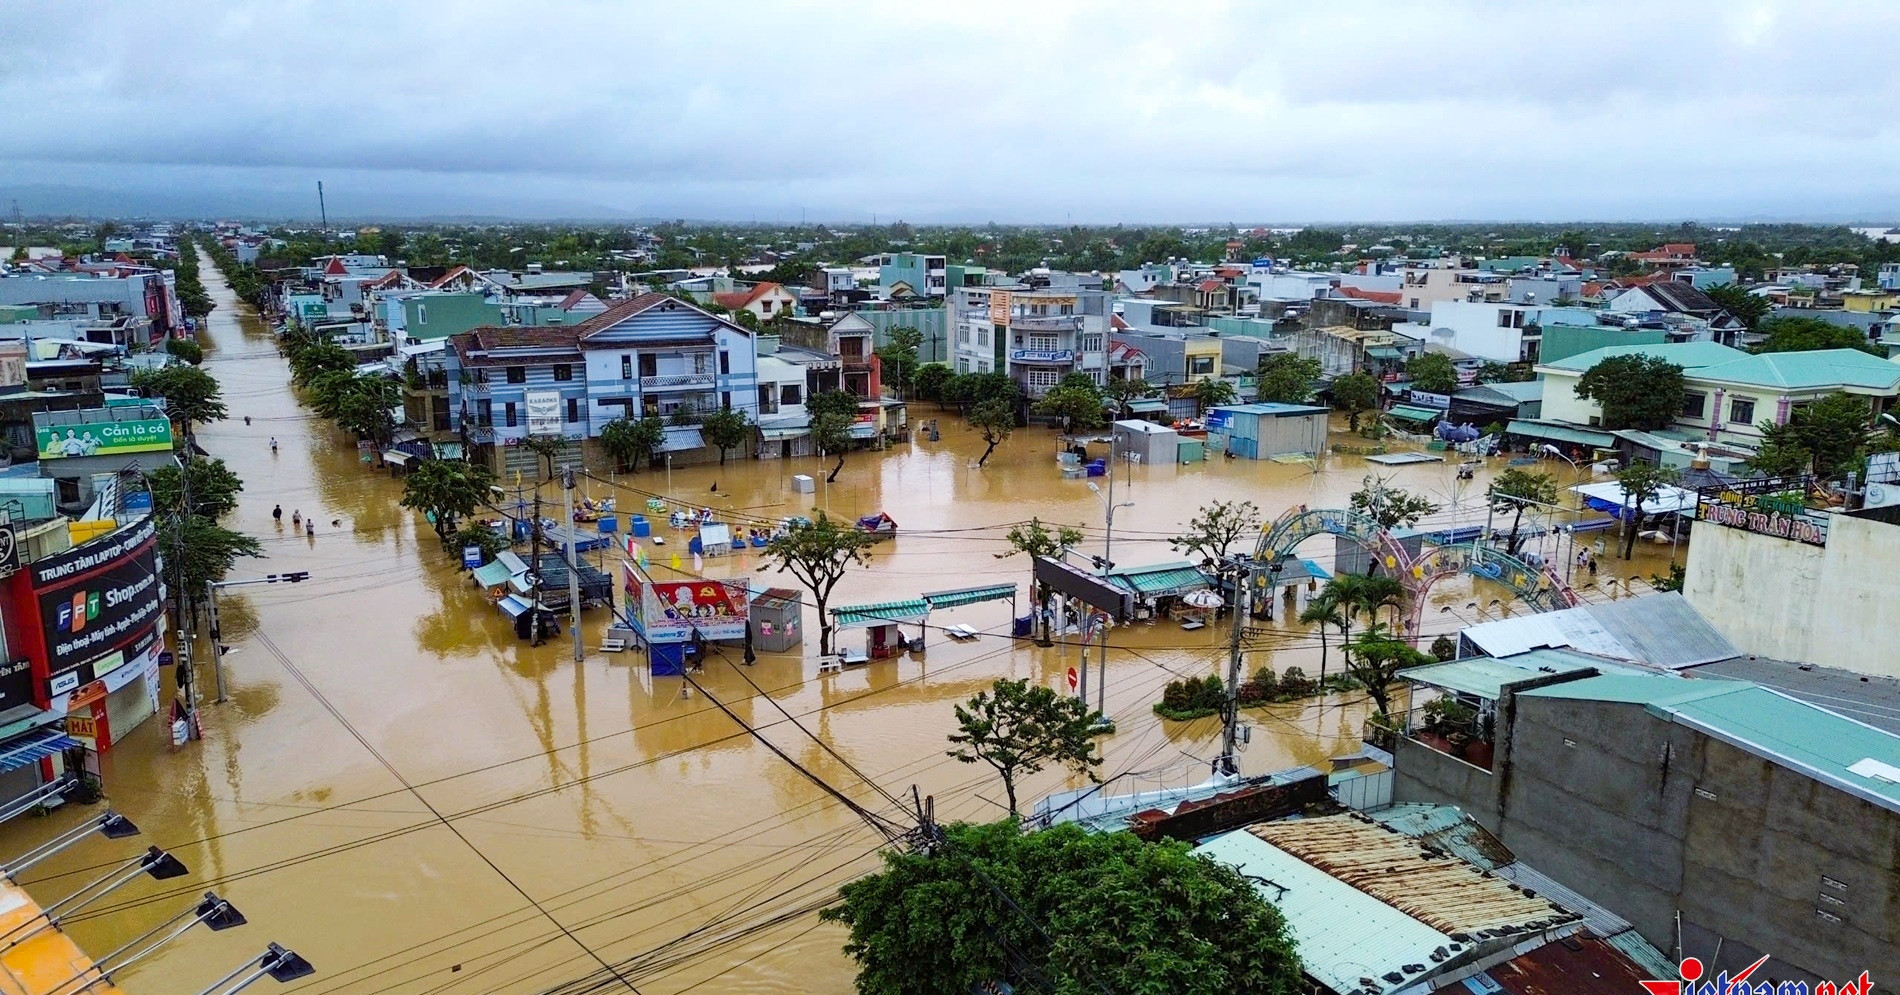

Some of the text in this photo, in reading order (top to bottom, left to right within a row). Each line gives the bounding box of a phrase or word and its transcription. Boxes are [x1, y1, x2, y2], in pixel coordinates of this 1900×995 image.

[102, 422, 165, 436] Cần là có
[1699, 503, 1822, 544] TRUNG TRẤN HÒA
[39, 562, 75, 582] TRUNG
[75, 556, 94, 571] TÂM
[94, 544, 121, 565] LAPTOP
[58, 595, 99, 629] FPT
[56, 642, 73, 656] Điện
[73, 634, 90, 648] thoại
[135, 633, 154, 652] SAMSUNG
[0, 661, 30, 677] ÊN TÂM
[55, 677, 75, 690] ASUS
